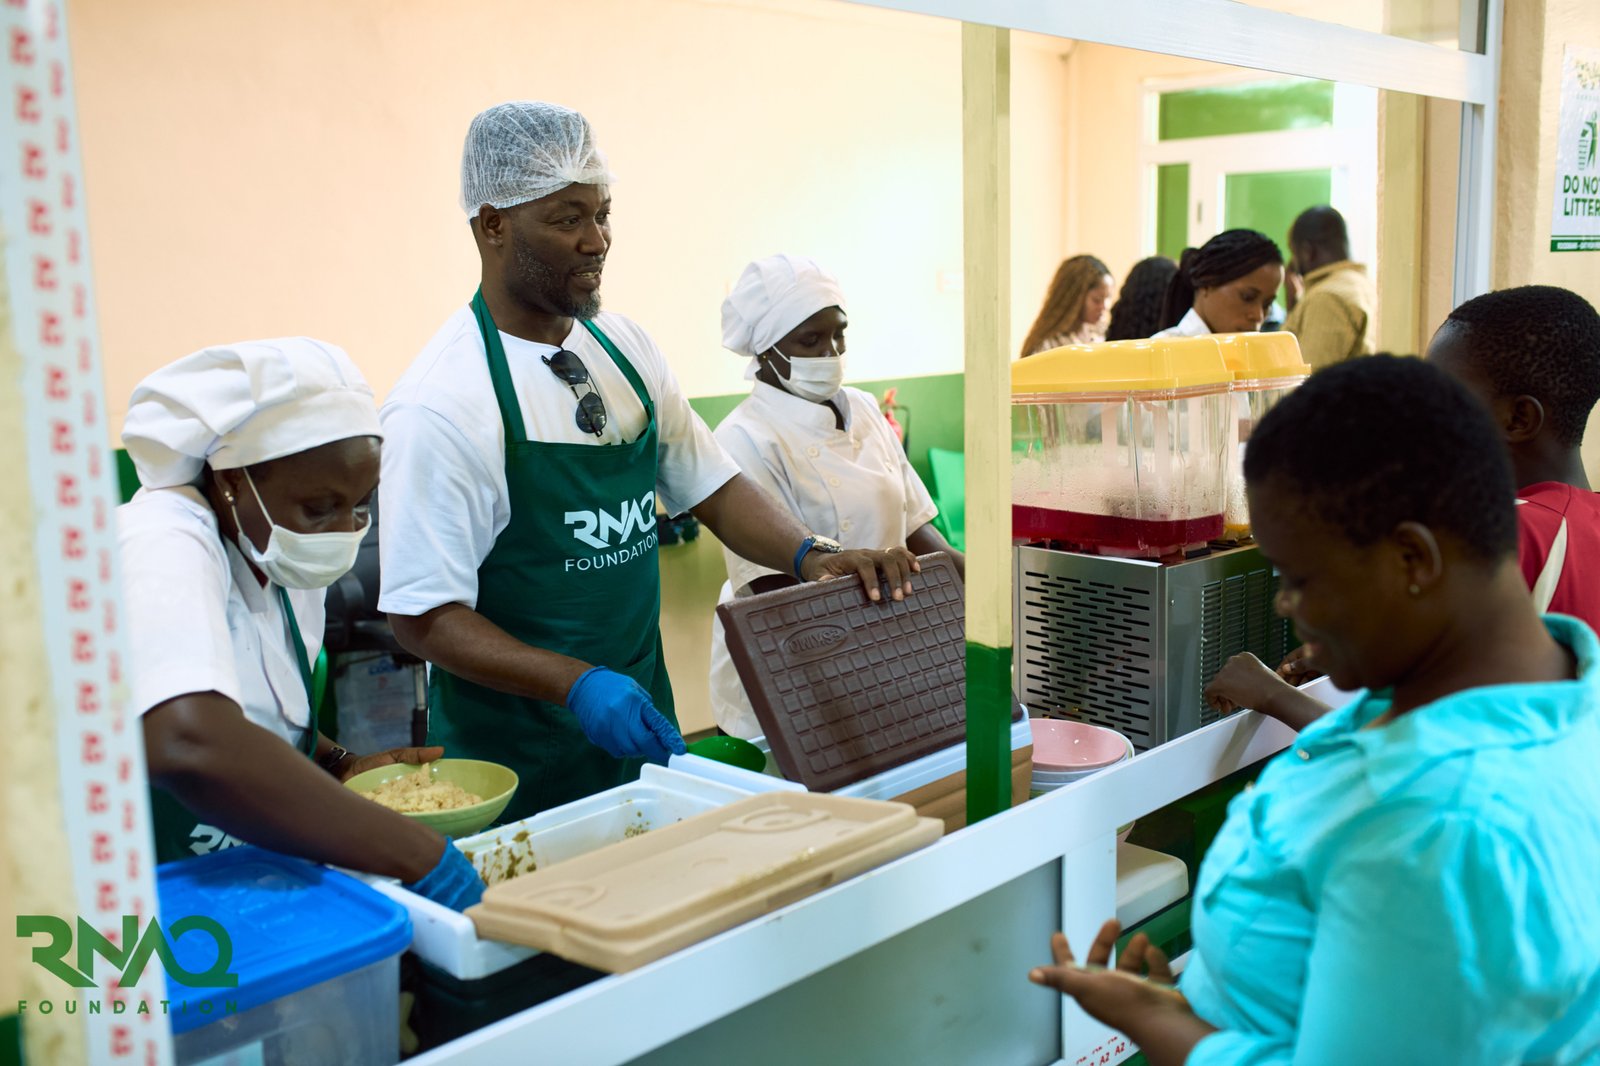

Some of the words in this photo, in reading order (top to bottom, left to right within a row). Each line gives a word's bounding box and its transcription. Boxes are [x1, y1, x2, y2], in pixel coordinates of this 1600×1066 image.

[1563, 175, 1579, 194] DO
[1582, 176, 1600, 195] NO
[1564, 198, 1600, 216] LITTER
[565, 530, 658, 572] FOUNDATION
